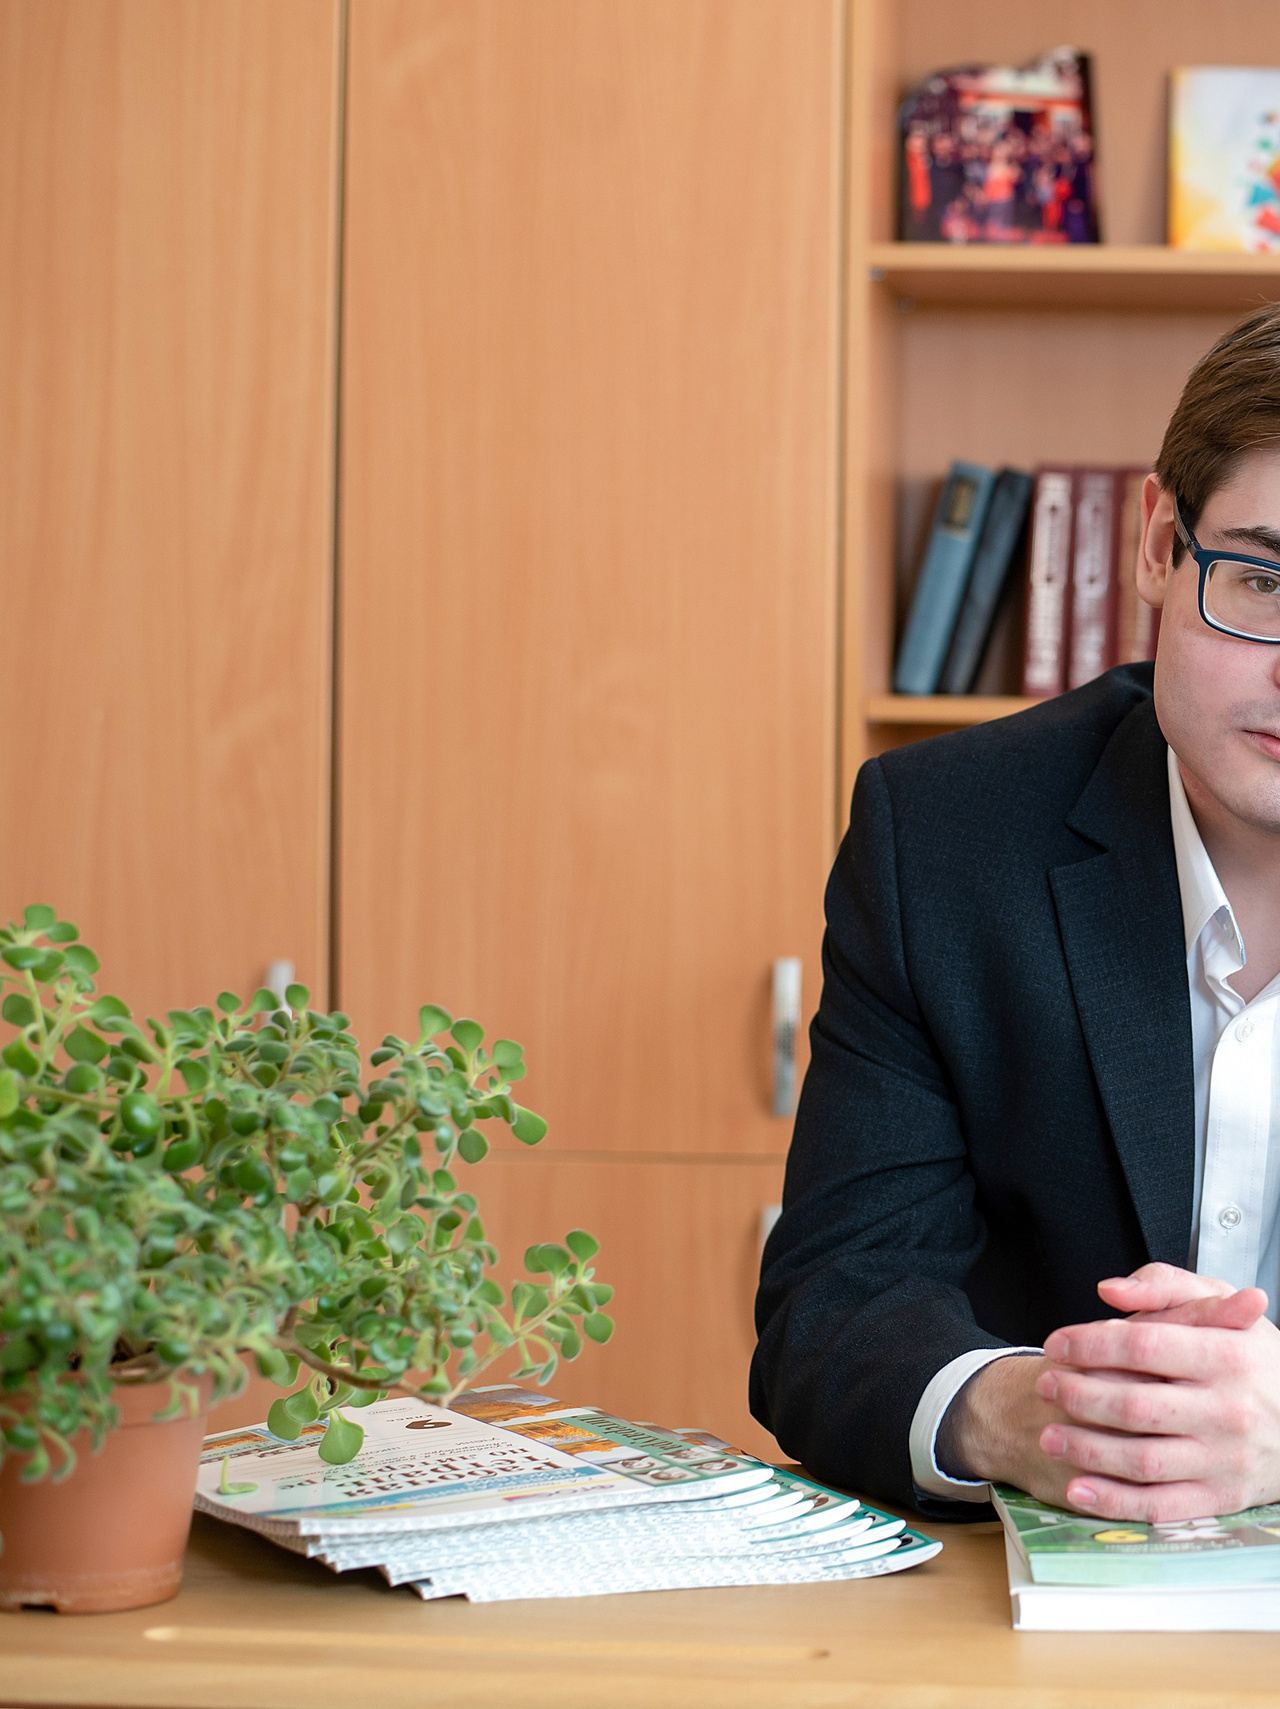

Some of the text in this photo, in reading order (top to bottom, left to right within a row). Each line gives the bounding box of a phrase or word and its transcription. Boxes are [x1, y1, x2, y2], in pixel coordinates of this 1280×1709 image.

[405, 1419, 452, 1430] 9
[489, 1448, 529, 1457] по
[277, 1454, 477, 1491] литературе
[336, 1455, 550, 1488] тетрадь
[343, 1461, 563, 1497] Рабочая
